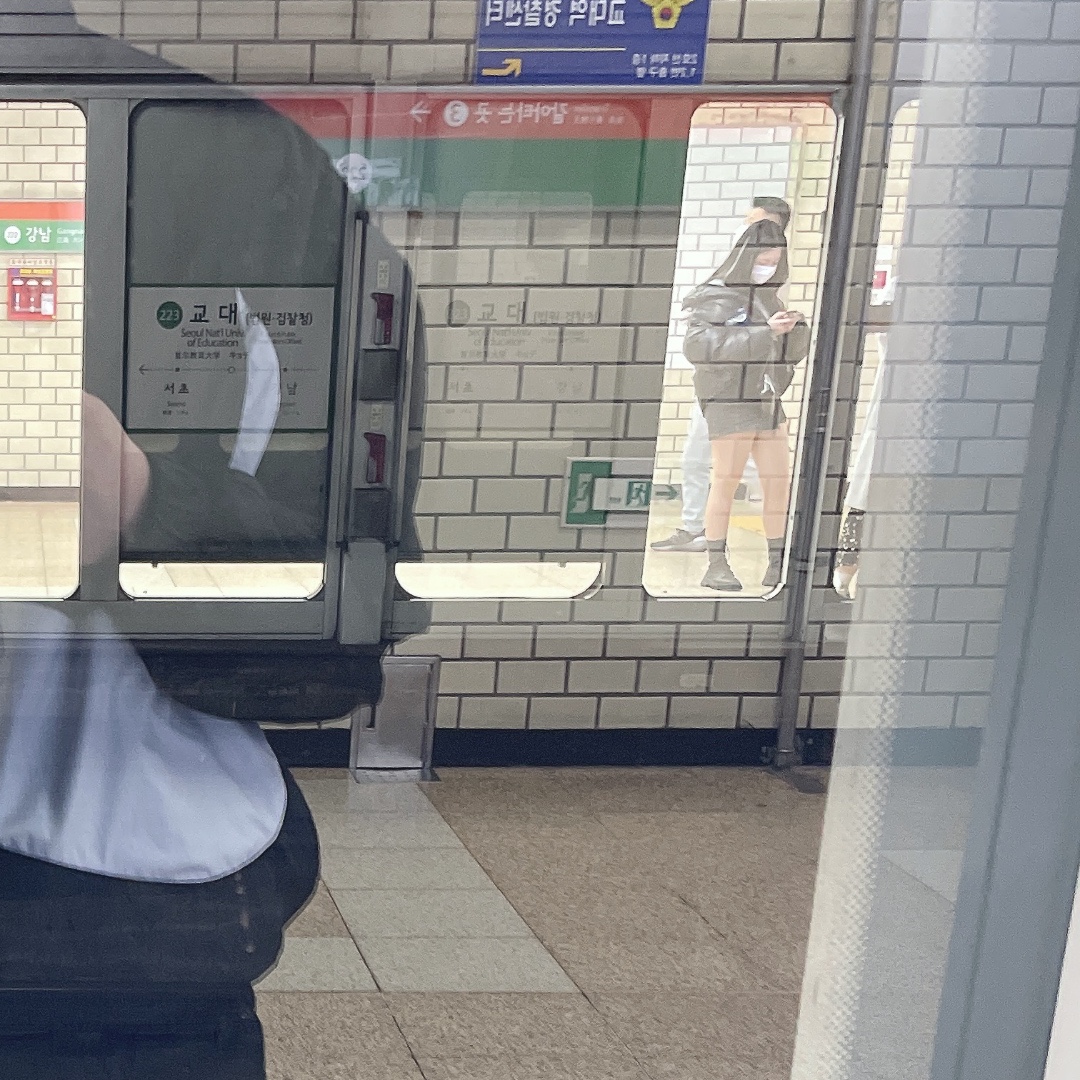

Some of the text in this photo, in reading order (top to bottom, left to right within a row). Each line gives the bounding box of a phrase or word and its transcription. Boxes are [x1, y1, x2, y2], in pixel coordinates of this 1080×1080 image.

[25, 226, 52, 243] 강남
[159, 309, 180, 320] 223
[181, 327, 204, 338] Seoul
[187, 338, 239, 348] of Education
